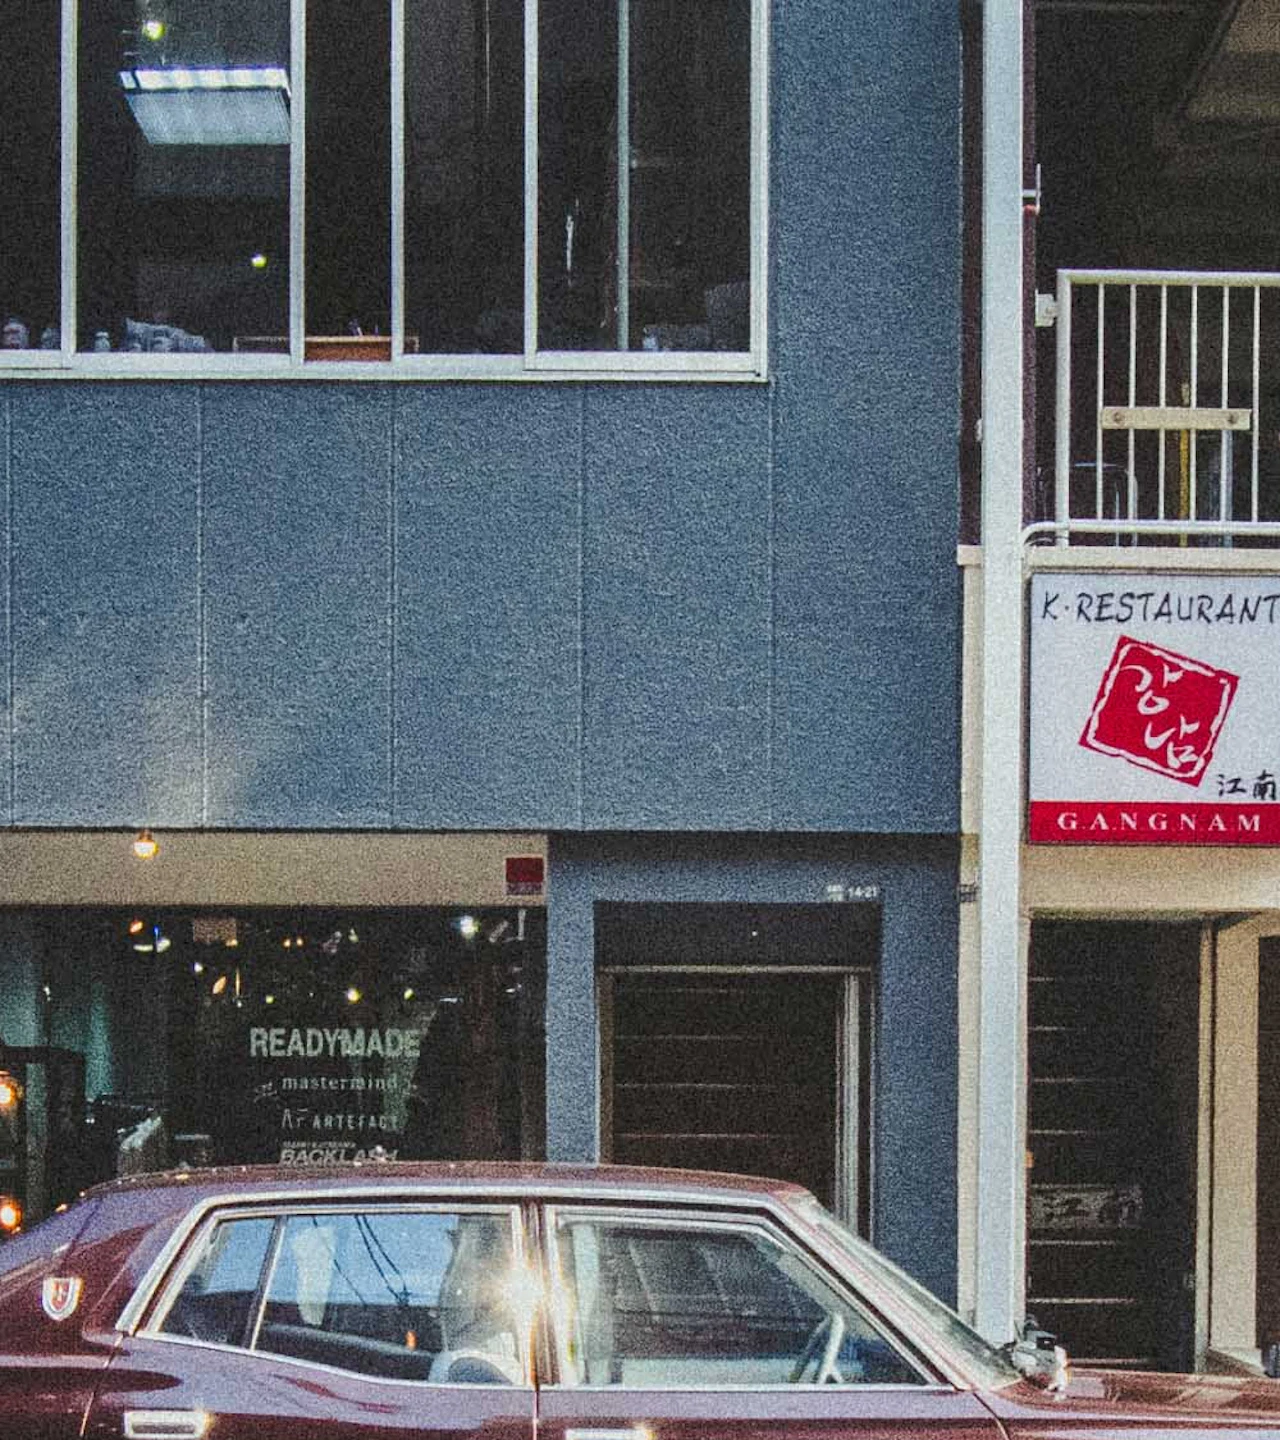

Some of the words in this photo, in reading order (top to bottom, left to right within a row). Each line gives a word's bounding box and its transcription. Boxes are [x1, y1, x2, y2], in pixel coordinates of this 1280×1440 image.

[1217, 769, 1276, 801] 江南
[249, 1027, 420, 1058] READYMADE
[282, 1073, 398, 1090] mastermind
